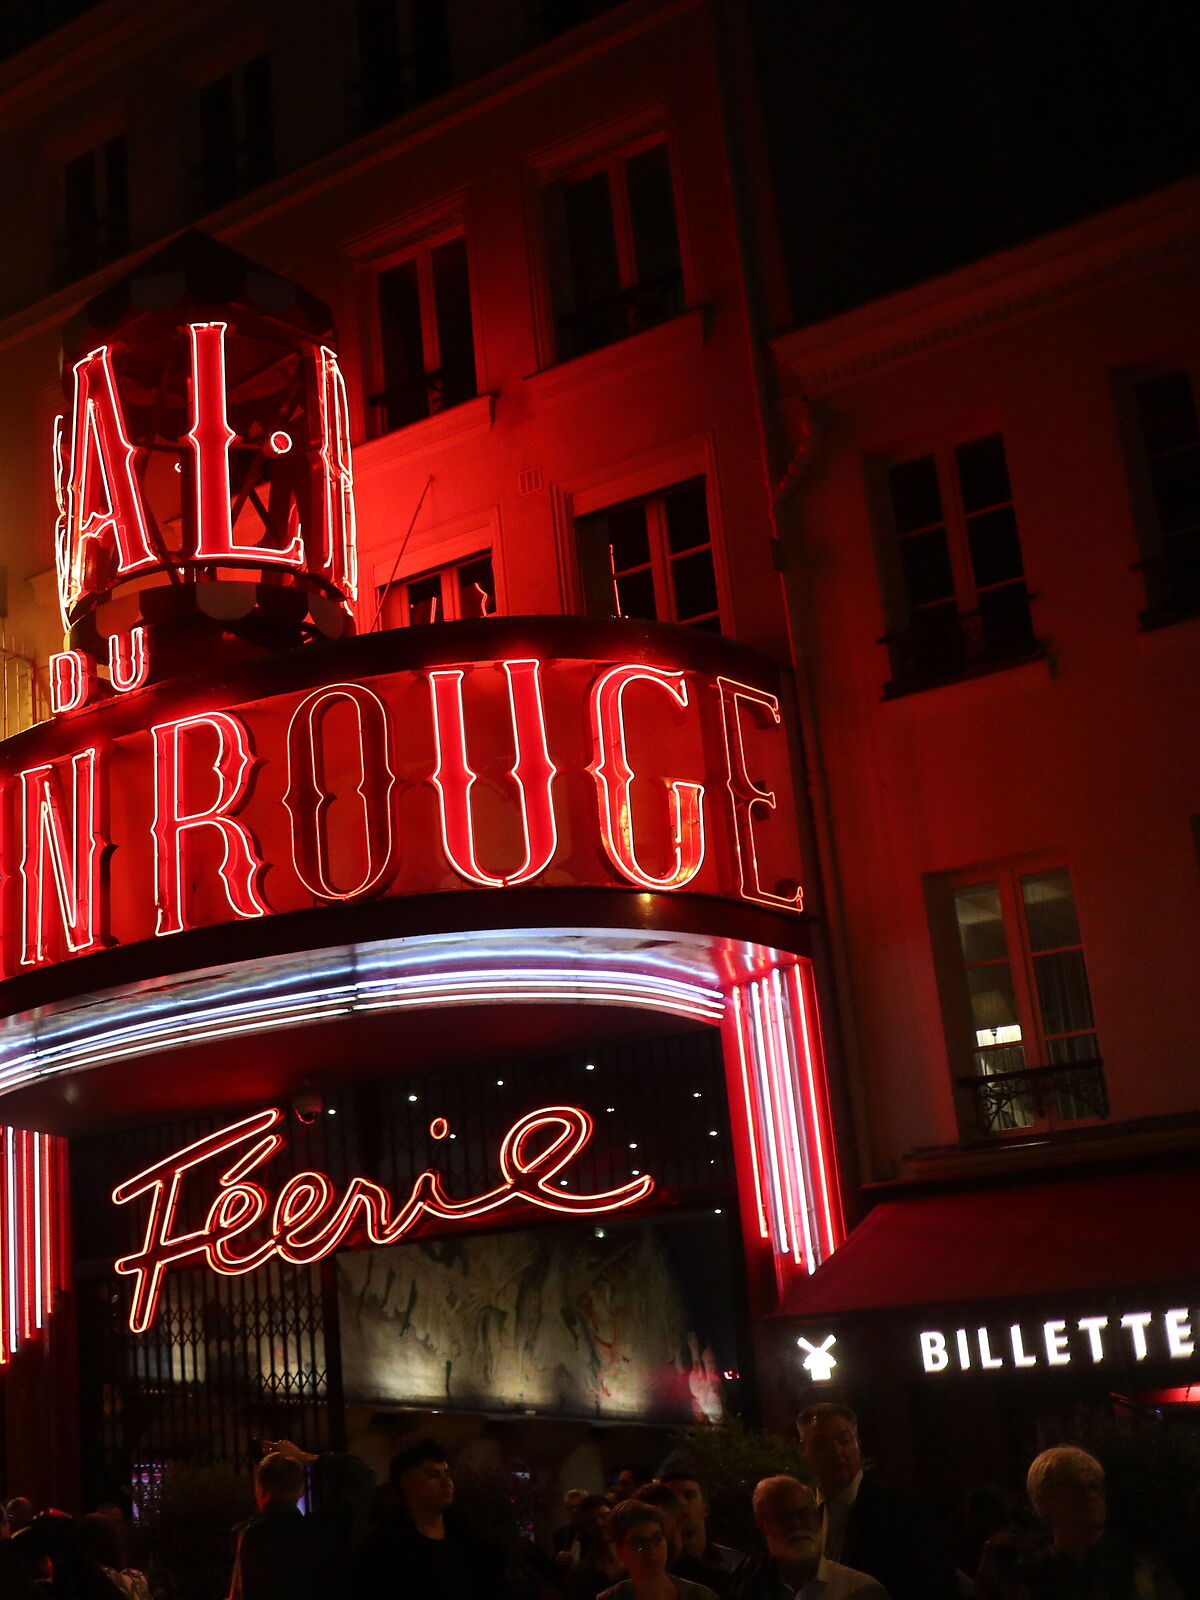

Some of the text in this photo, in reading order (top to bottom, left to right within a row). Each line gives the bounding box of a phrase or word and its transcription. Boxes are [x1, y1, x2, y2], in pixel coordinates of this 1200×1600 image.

[54, 321, 304, 632] AL
[50, 626, 150, 713] DU
[151, 657, 804, 937] ROUGE
[112, 1106, 655, 1333] Féerie
[919, 1308, 1196, 1373] BILLETTE
